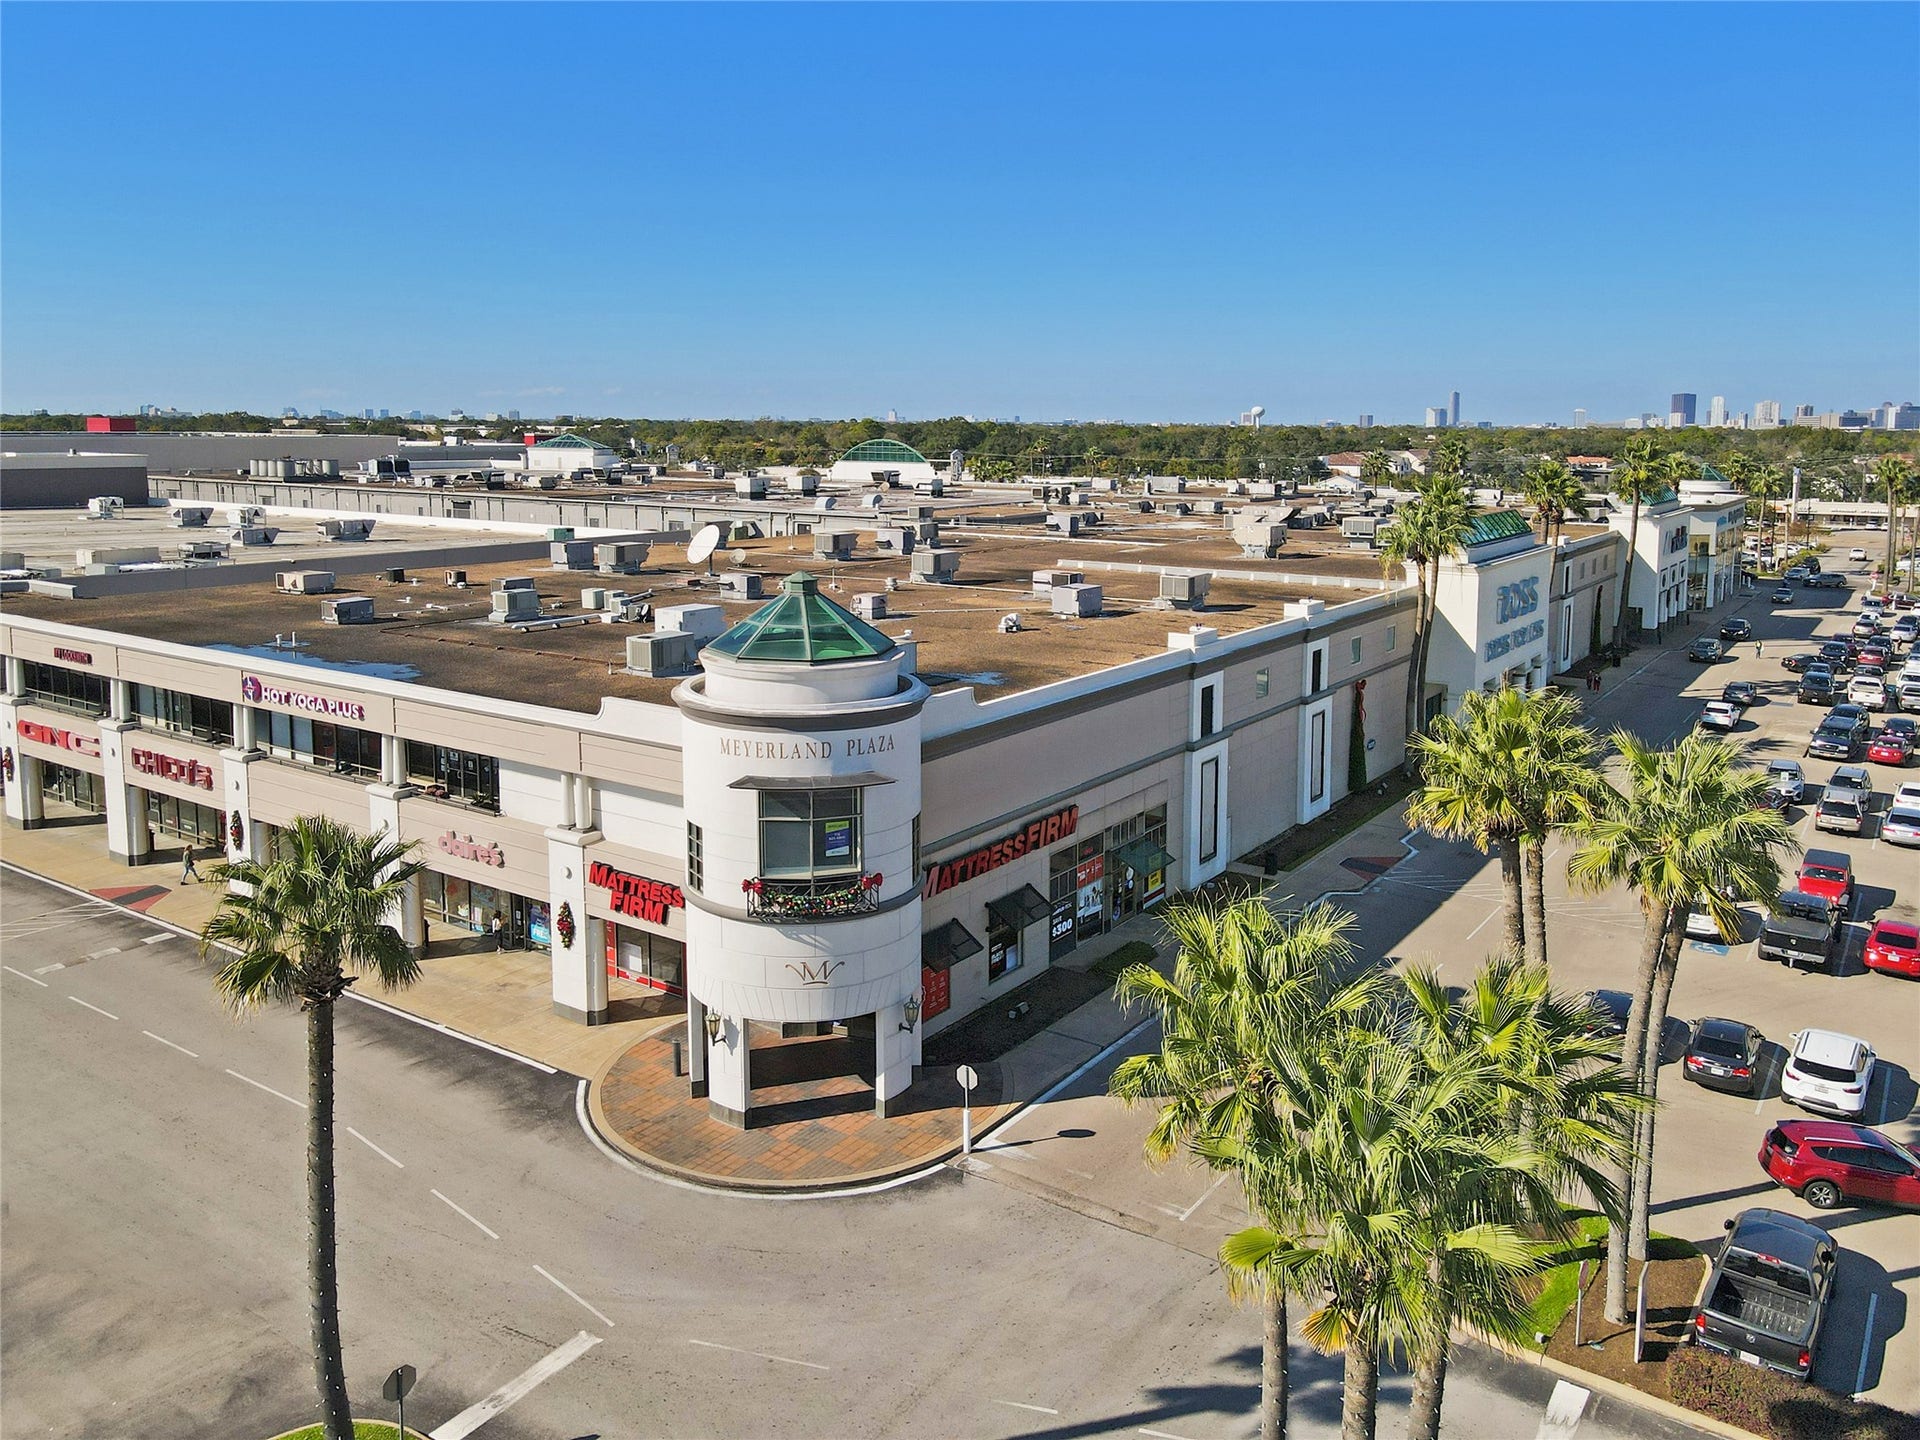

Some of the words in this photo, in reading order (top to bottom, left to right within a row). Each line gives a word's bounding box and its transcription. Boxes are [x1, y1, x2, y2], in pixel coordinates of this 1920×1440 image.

[1496, 576, 1539, 624] ROSS
[262, 687, 290, 705] HOT
[290, 692, 325, 713] YOGA
[328, 700, 366, 721] PLUS
[18, 720, 101, 758] GNC
[720, 737, 832, 760] MEYERLAND
[846, 734, 895, 757] PLAZA
[131, 747, 214, 791] CHICO'S
[588, 861, 686, 908] MATTRESS
[610, 890, 669, 925] FIRM
[1052, 918, 1073, 937] $300
